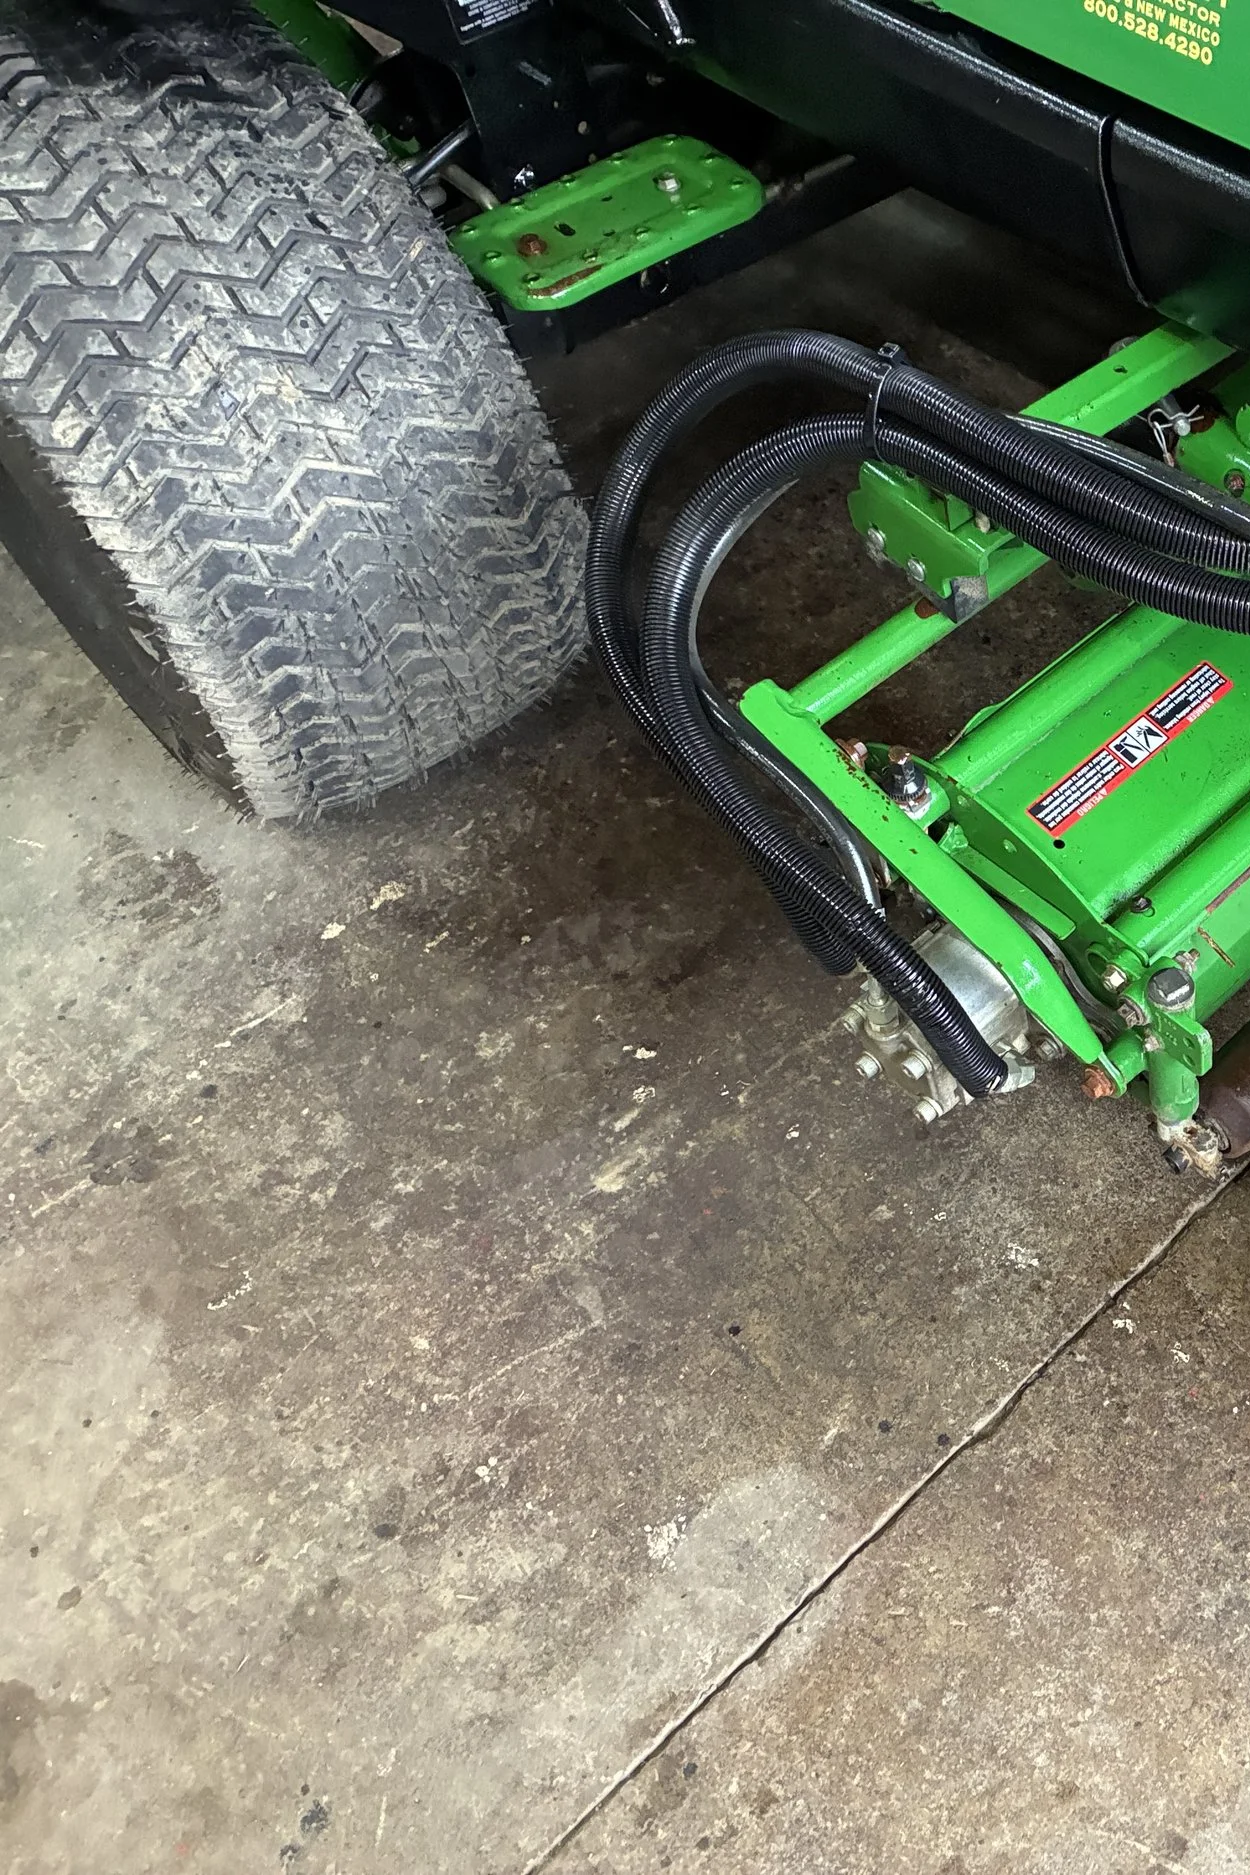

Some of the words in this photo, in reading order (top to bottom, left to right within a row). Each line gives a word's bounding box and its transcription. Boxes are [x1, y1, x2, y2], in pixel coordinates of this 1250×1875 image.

[1136, 0, 1167, 23] NEW
[1168, 12, 1221, 47] MEXICO
[1157, 0, 1221, 28] ACTOR
[1083, 0, 1213, 66] 800.528.4290
[1185, 700, 1211, 723] DANGER
[1075, 792, 1103, 817] PELIGRO
